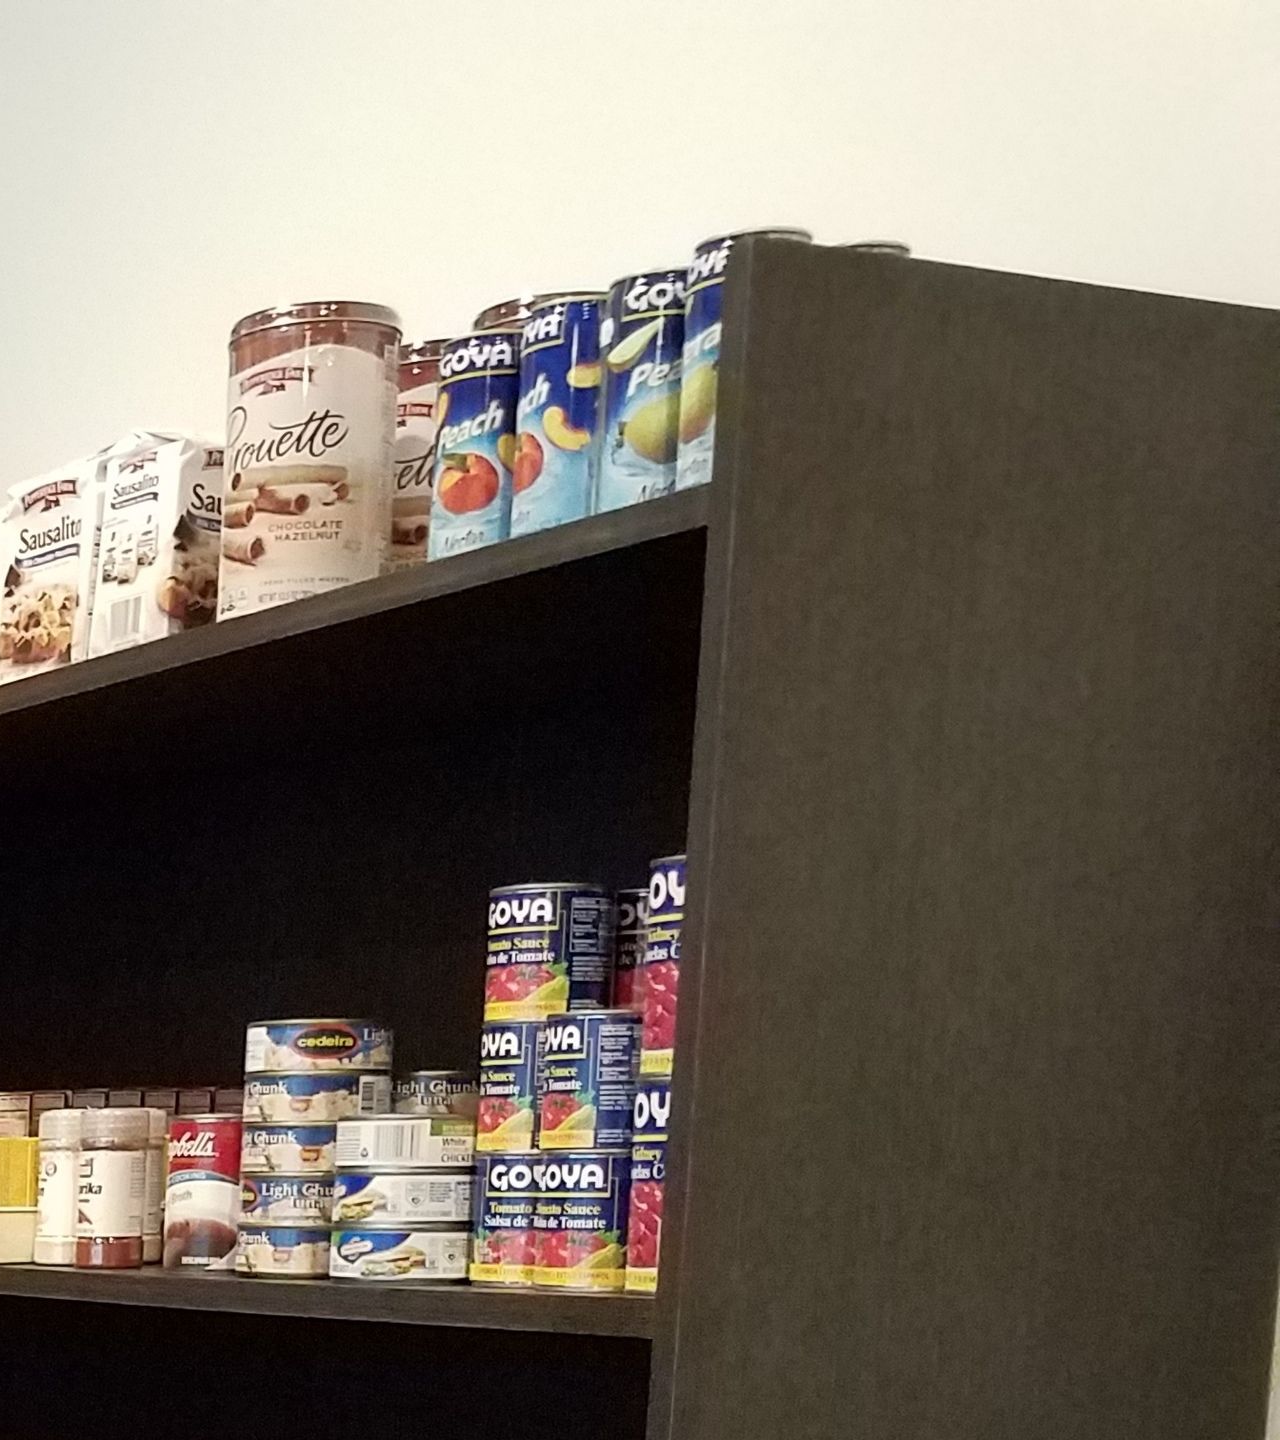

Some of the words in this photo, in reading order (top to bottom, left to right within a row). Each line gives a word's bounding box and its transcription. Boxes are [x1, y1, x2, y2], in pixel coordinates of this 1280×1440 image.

[441, 341, 513, 377] GOYA
[439, 400, 504, 450] Peach
[113, 474, 159, 501] Sausalito
[268, 519, 343, 533] CHOCOLATE
[19, 515, 82, 555] Sausalito
[274, 531, 341, 542] HAZELNUT
[488, 897, 554, 928] GOYA
[513, 937, 550, 950] Sauce
[510, 950, 556, 963] Tomate
[297, 1034, 354, 1049] cedeira
[249, 1080, 288, 1094] Chunk
[253, 1130, 298, 1145] Chunk
[442, 1138, 467, 1148] White
[261, 1183, 299, 1198] Light
[289, 1196, 326, 1209] Tuna
[489, 1201, 533, 1215] Tomato
[563, 1201, 602, 1216] Sauce
[483, 1213, 512, 1228] Salsa
[513, 1215, 529, 1228] de
[559, 1216, 607, 1231] Tomate
